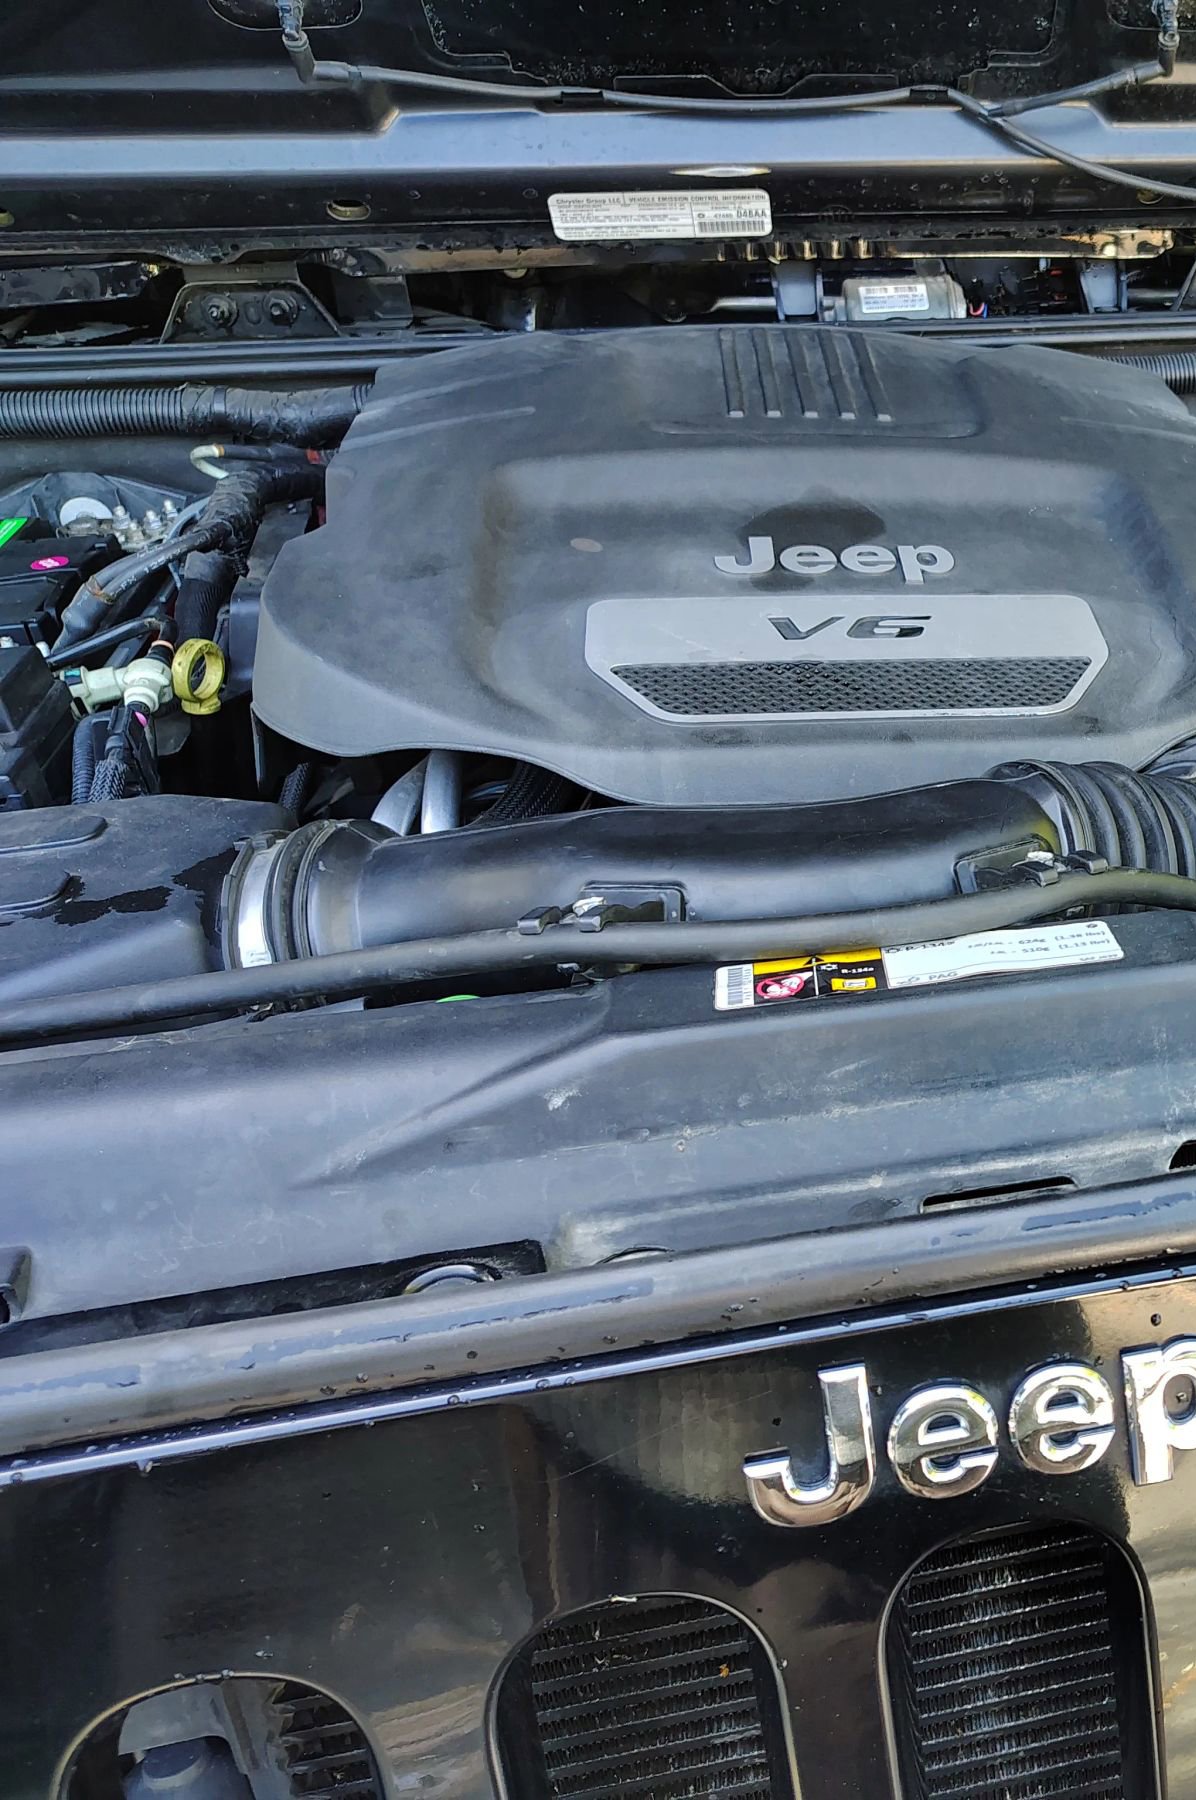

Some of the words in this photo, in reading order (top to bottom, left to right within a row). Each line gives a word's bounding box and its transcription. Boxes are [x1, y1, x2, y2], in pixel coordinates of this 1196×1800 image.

[714, 536, 955, 585] Jeep
[767, 615, 932, 641] V6
[928, 971, 959, 981] PAG
